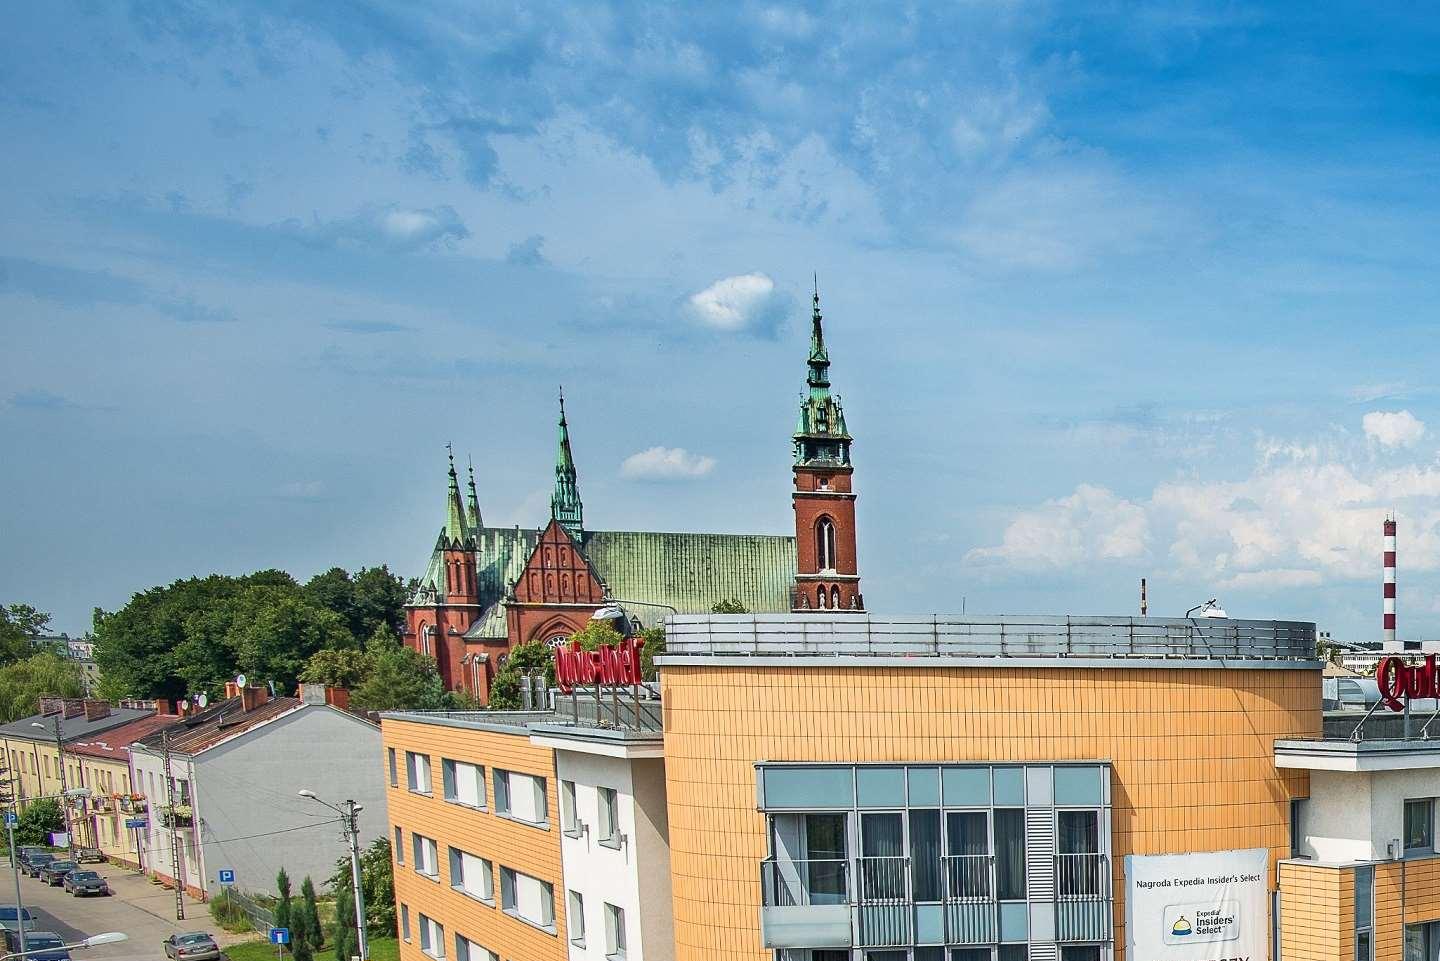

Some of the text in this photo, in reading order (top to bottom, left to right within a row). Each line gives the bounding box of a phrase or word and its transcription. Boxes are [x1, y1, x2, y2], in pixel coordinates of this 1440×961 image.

[223, 872, 231, 881] P
[1136, 874, 1260, 890] Nagroda Expedia Insider's Select
[1196, 910, 1220, 918] Expedia
[1196, 915, 1235, 927] Insiders'
